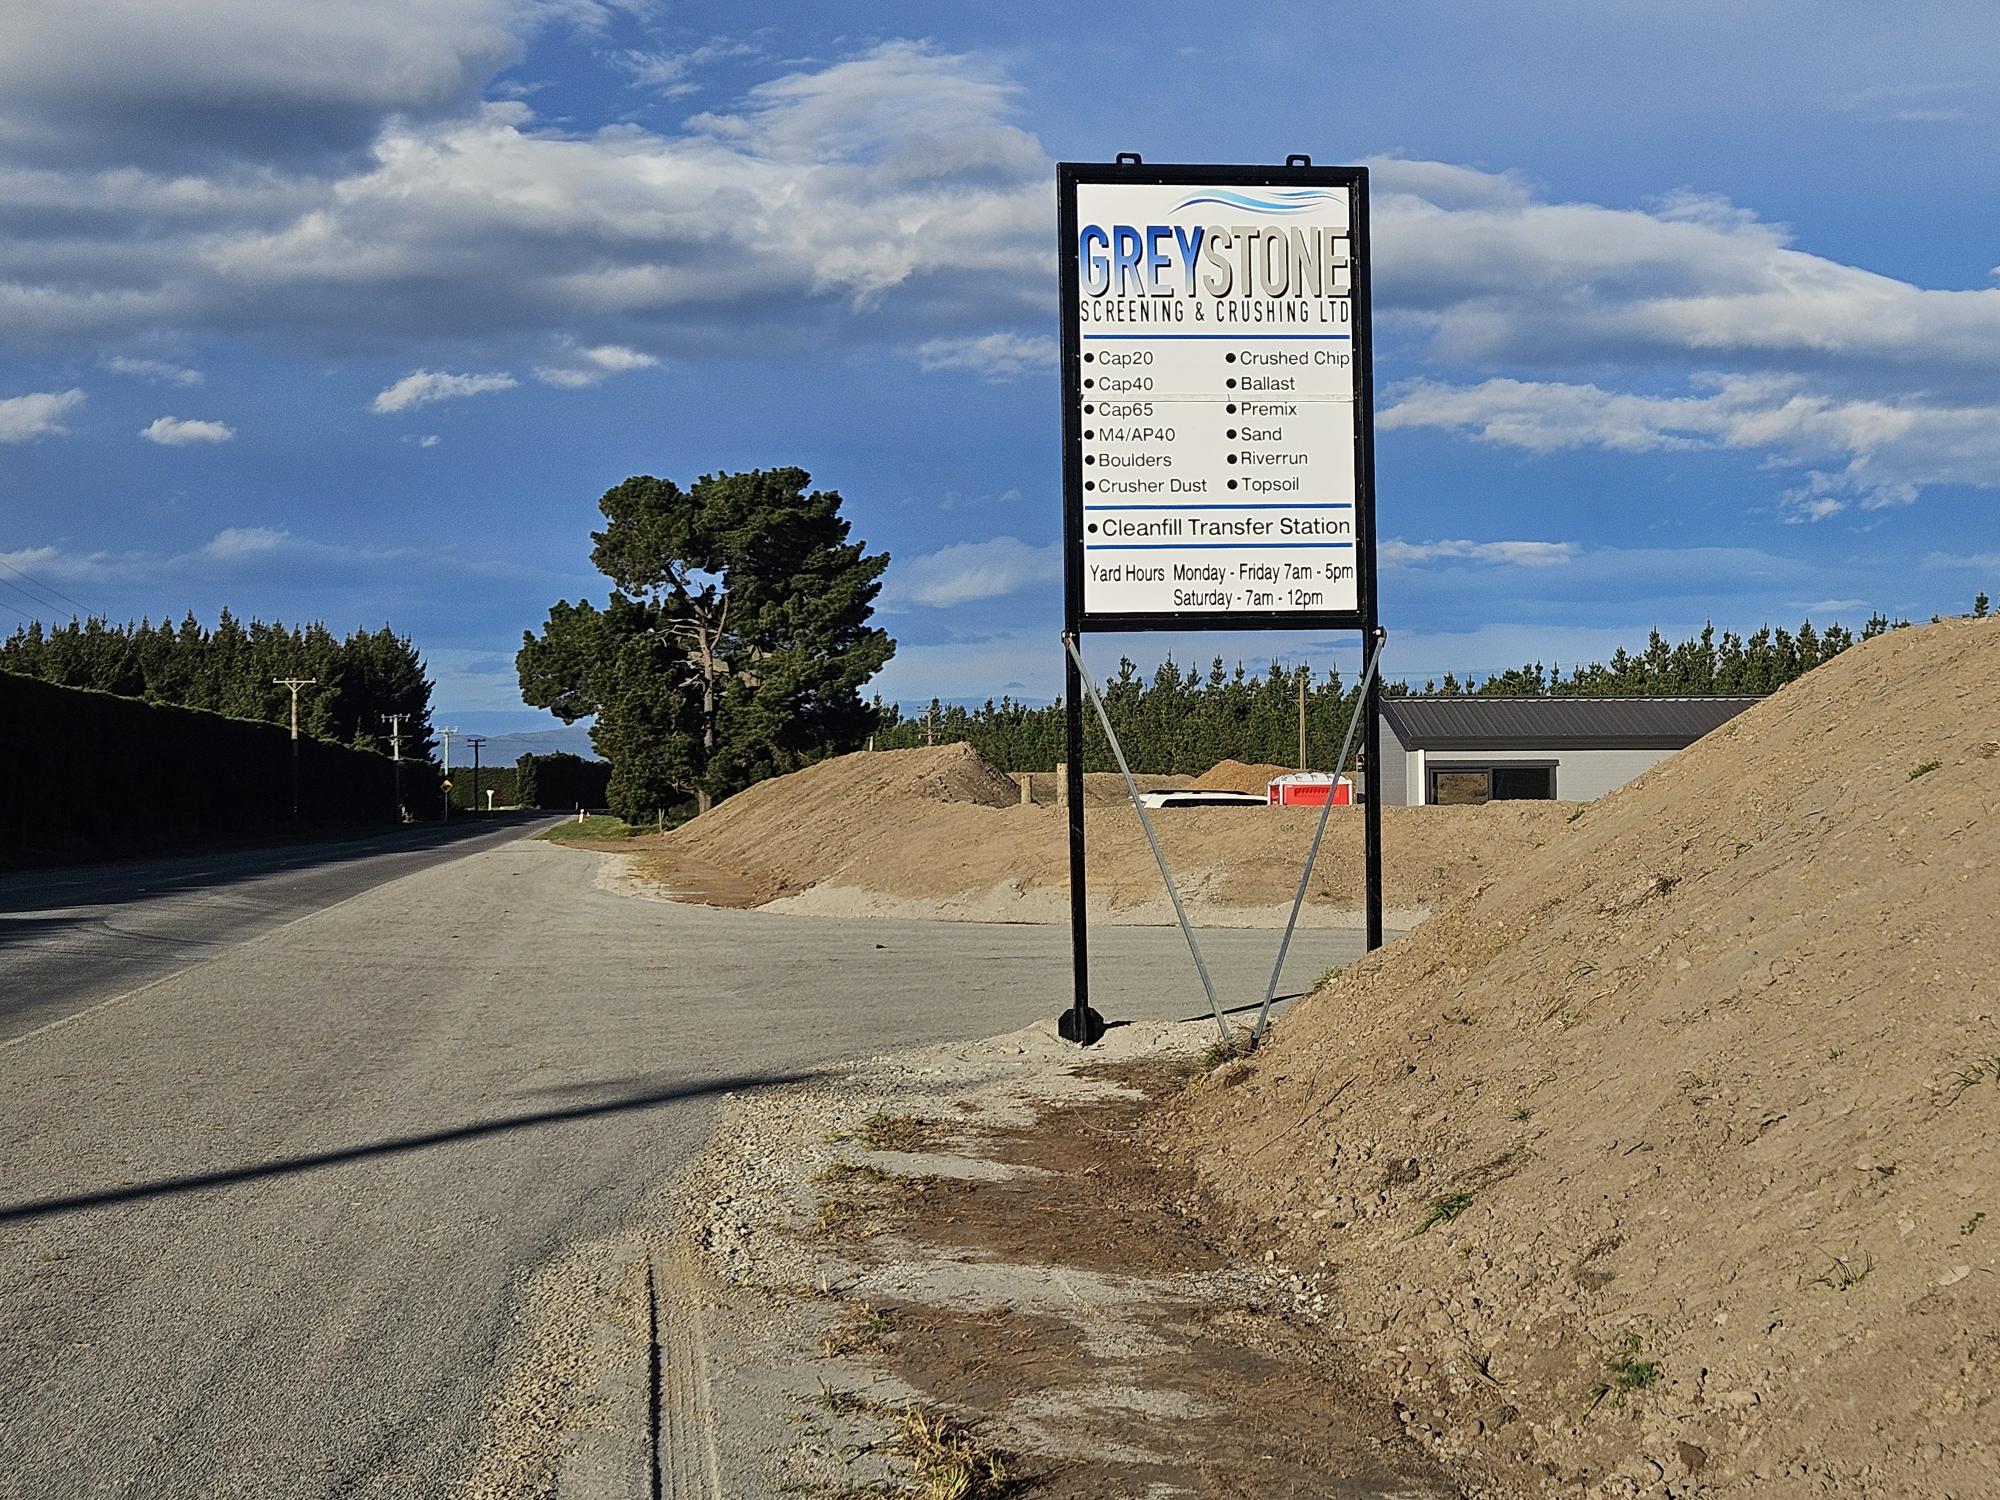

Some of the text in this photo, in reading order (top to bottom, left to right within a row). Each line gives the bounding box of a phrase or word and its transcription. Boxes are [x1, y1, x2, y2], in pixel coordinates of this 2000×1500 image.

[1079, 224, 1351, 298] GREYSTONE
[1081, 300, 1349, 322] SCREENING & CRUSHING LTD
[1098, 351, 1154, 368] Cap20
[1240, 350, 1350, 368] Crushed Chip
[1098, 377, 1154, 394] Cap40
[1241, 376, 1295, 390] Ballast
[1098, 403, 1154, 419] Cap65
[1241, 402, 1297, 416] Premix
[1099, 428, 1176, 442] M4/AP40
[1241, 427, 1282, 441] Sand
[1099, 453, 1172, 467] Boulders
[1241, 451, 1308, 465] Riverrun
[1098, 478, 1207, 492] Crusher Dust
[1242, 477, 1299, 494] Topsoil
[1102, 518, 1350, 536] Cleanfill Transfer Station
[1090, 564, 1121, 582] Yard
[1126, 564, 1164, 582] Hours
[1174, 564, 1226, 585] Monday
[1240, 563, 1280, 584] Friday
[1284, 563, 1312, 580] 7am
[1325, 563, 1353, 584] 5pm
[1174, 589, 1232, 610] Saturday
[1246, 589, 1274, 606] 7am
[1288, 589, 1323, 610] 12pm
